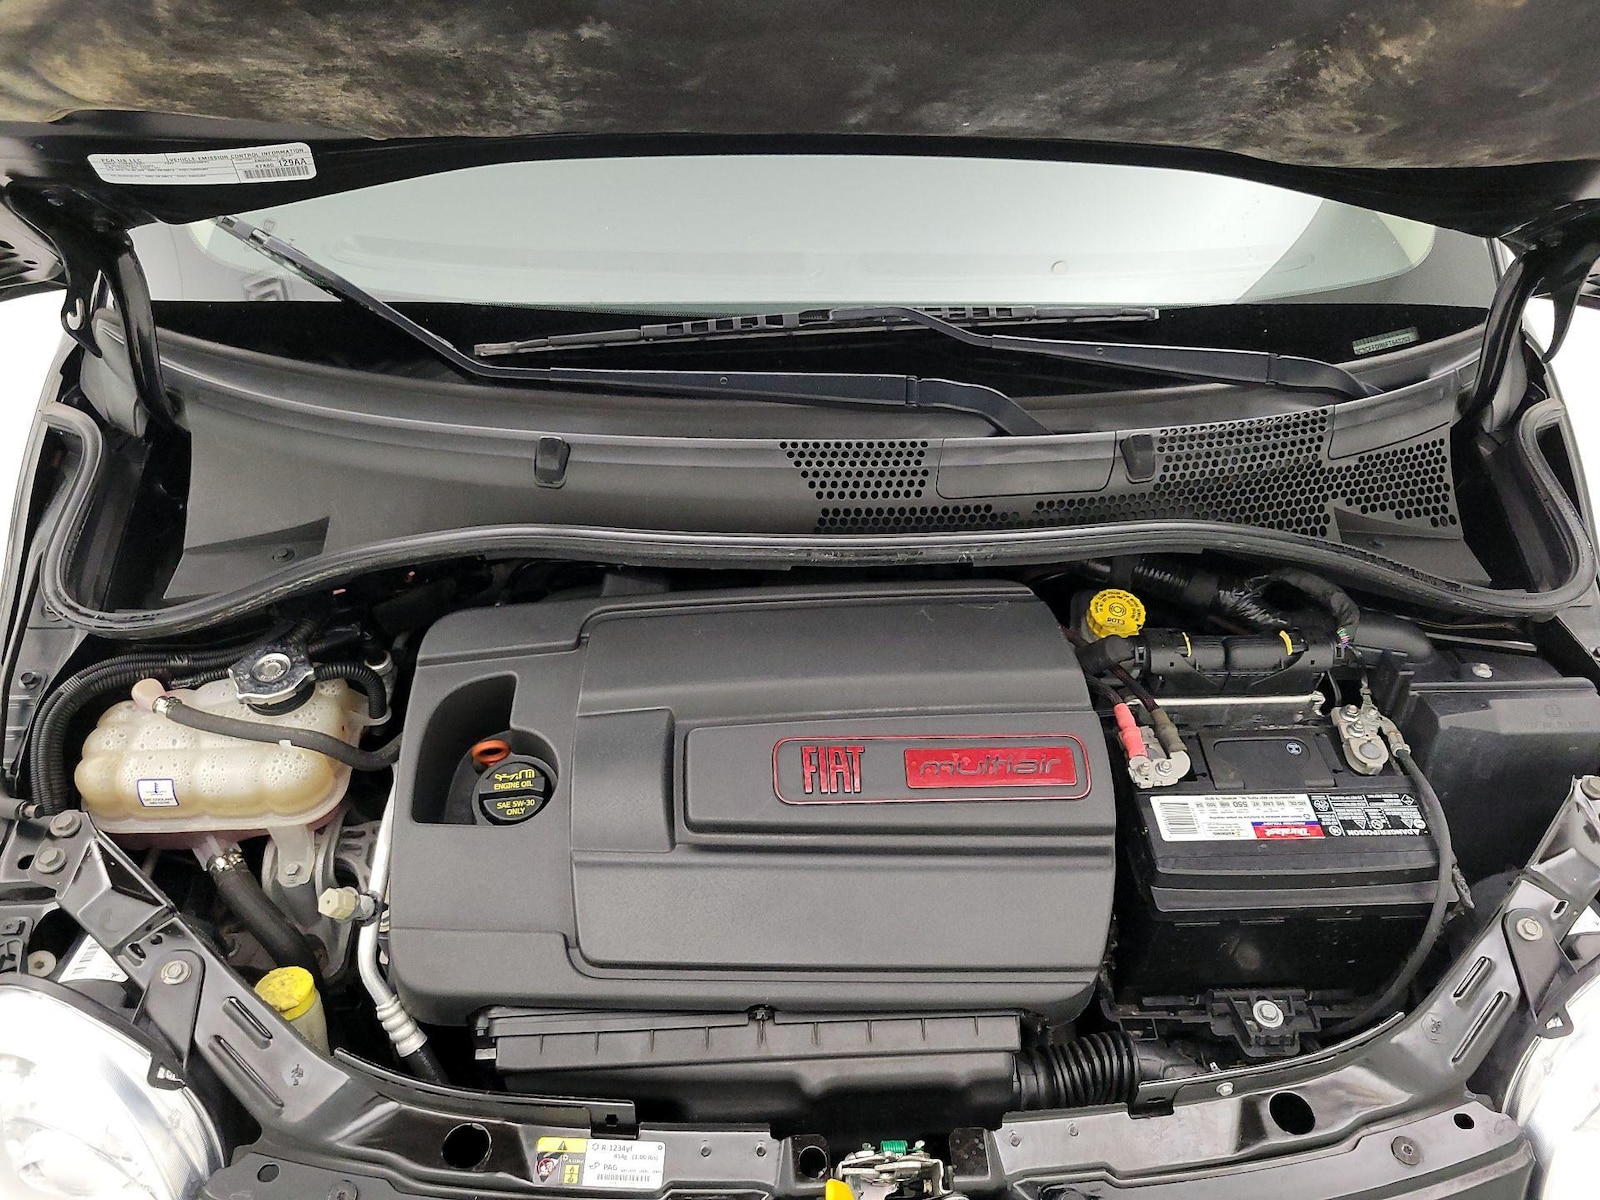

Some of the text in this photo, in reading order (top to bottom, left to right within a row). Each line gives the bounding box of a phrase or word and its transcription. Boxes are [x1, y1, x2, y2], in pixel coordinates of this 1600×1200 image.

[261, 148, 304, 156] INFORMATION
[801, 745, 1061, 795] FIAT multiair
[494, 782, 520, 790] ENGINE
[512, 799, 535, 807] 5W-30
[1264, 827, 1310, 836] Duralast
